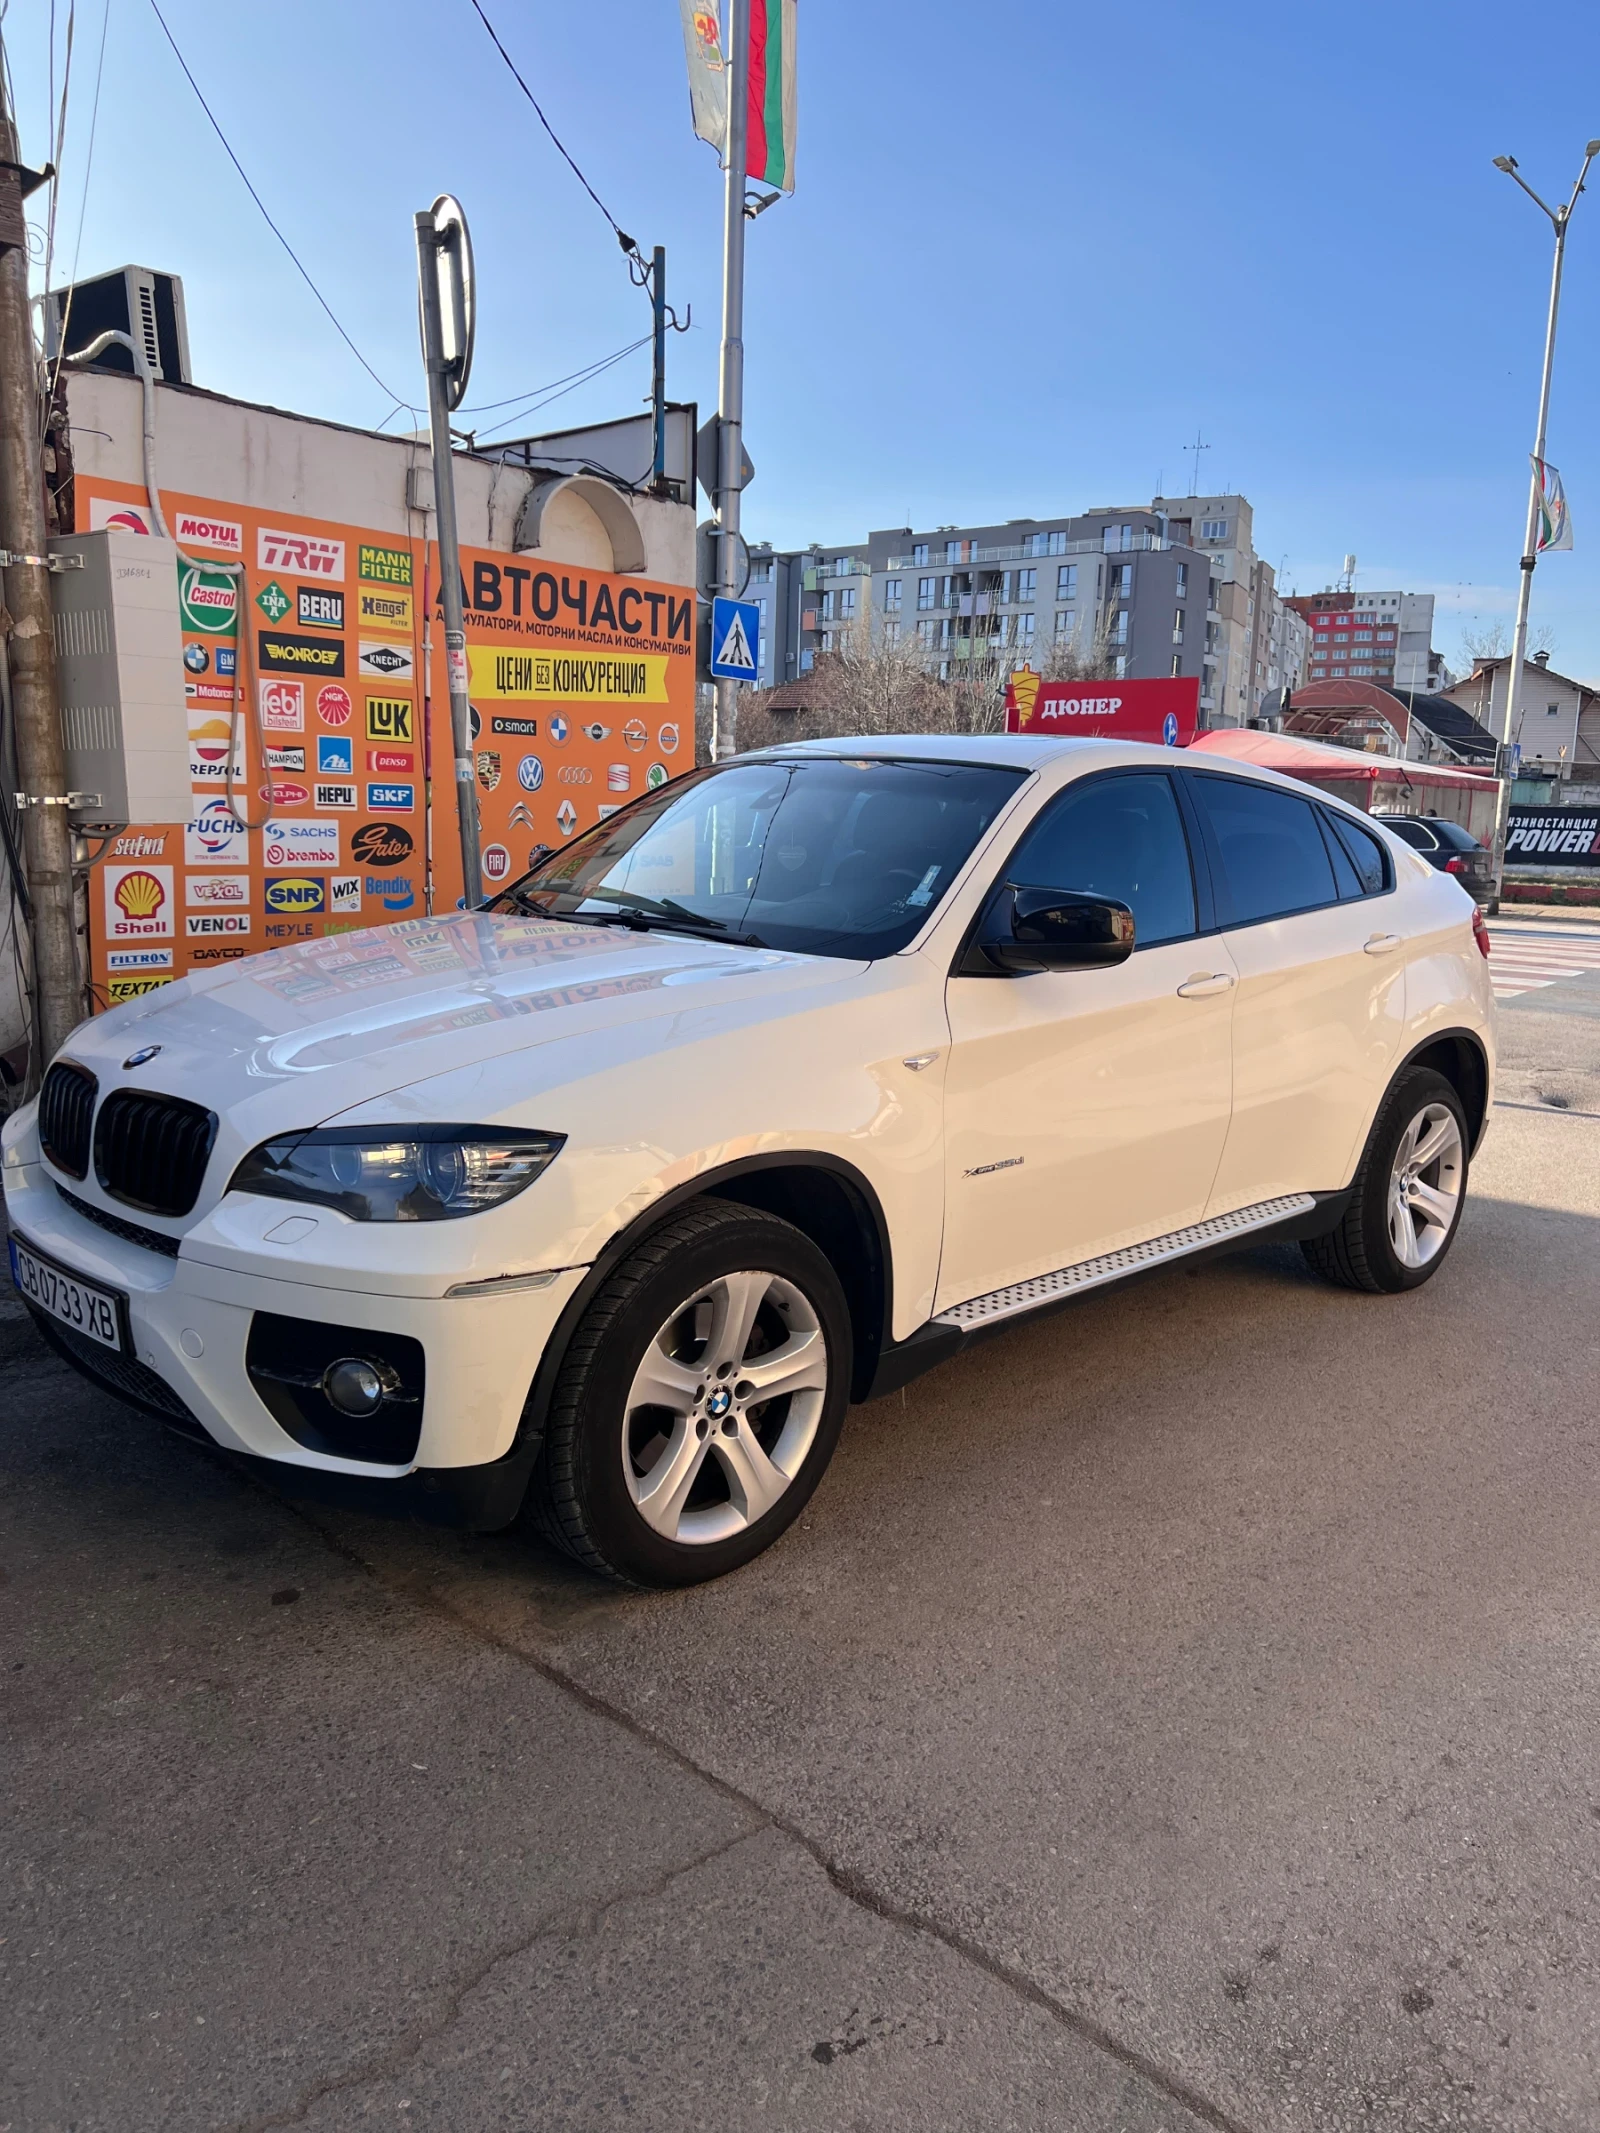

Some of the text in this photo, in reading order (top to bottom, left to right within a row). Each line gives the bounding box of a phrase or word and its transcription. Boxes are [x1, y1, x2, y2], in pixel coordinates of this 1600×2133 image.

[180, 520, 238, 541] MOTUL
[264, 536, 339, 573] TRW
[361, 548, 411, 569] MANN
[361, 563, 411, 583] FILTER
[191, 587, 235, 607] Castrol
[299, 594, 342, 621] BERU
[362, 596, 408, 618] Hengst
[390, 619, 408, 627] FILTER
[526, 622, 575, 640] МОТОРНИ
[578, 629, 613, 646] МАСЛА
[615, 635, 622, 646] И
[624, 636, 691, 655] КОНСУМАТИВИ
[221, 653, 235, 665] GM
[274, 645, 331, 665] MONROE
[369, 654, 403, 667] KNECHT
[496, 656, 532, 694] ЦЕНИ
[536, 664, 550, 685] БЕЗ
[553, 658, 646, 697] КОНКУРЕНЦИЯ
[262, 683, 300, 716] febi
[324, 692, 344, 702] NGK
[1041, 698, 1122, 719] ДЮНЕР
[267, 716, 298, 728] bilstein
[504, 721, 534, 734] smart
[267, 753, 303, 764] HAMPION
[379, 757, 407, 767] DENSO
[190, 764, 242, 776] REPSOL
[264, 790, 303, 798] DELPHI
[317, 786, 352, 803] HEPU
[372, 788, 410, 802] SKF
[187, 819, 245, 833] FUCHS
[1507, 816, 1598, 830] НЗИНОСТАНЦИЯ
[290, 828, 337, 838] SACHS
[354, 827, 412, 863] Gates
[1505, 828, 1600, 853] POWER
[287, 849, 335, 861] brembo
[488, 853, 505, 866] FIAT
[333, 879, 360, 899] WIX
[366, 876, 412, 895] Bendix
[269, 887, 320, 904] SNR
[114, 921, 166, 934] Shell
[188, 918, 248, 932] VENOL
[265, 923, 313, 938] MEYLE
[111, 953, 168, 964] FILTRON
[193, 948, 245, 960] DAYCO
[111, 980, 172, 996] TEXTA
